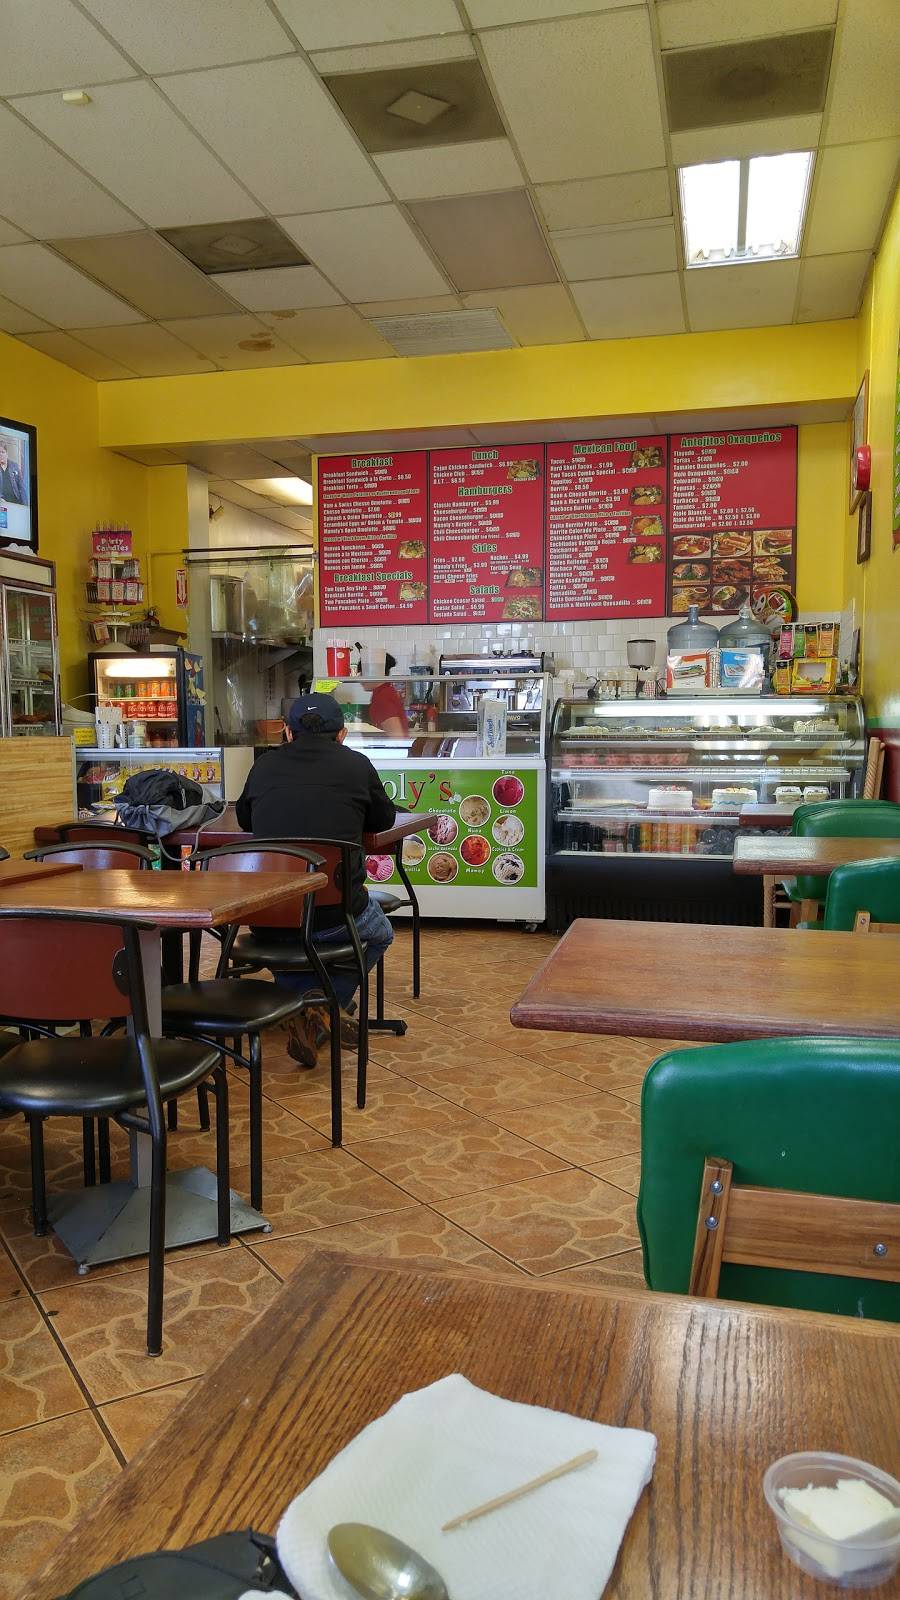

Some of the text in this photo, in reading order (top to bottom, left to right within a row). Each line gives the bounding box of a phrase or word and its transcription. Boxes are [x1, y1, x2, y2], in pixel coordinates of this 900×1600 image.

[681, 436, 725, 448] Antojitos
[573, 441, 637, 455] Mexican Food
[472, 450, 498, 460] Lunch
[352, 457, 393, 468] Breakfast
[458, 485, 512, 495] Hamburgers
[472, 542, 497, 553] Sides
[334, 571, 413, 583] Breakfast Specials
[470, 585, 499, 595] Salads
[382, 772, 454, 809] oly's
